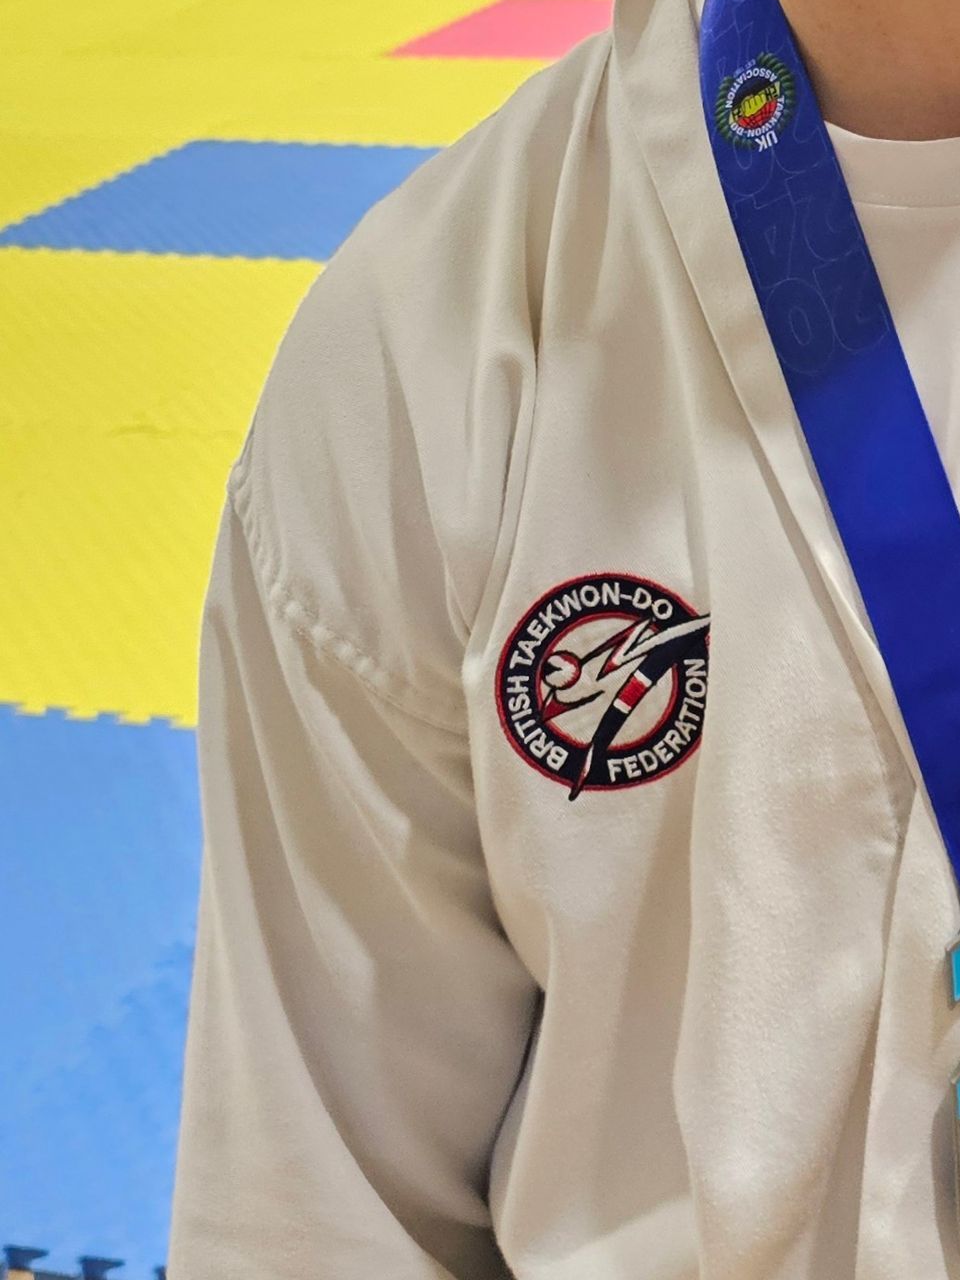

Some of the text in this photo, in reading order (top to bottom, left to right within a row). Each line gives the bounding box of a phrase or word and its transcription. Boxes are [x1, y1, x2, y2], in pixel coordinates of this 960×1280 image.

[725, 67, 778, 109] ASSOCIATION
[730, 94, 785, 138] TAEKWON-DO
[755, 130, 778, 153] UK
[506, 582, 673, 771] BRITISH TAEKWON-DO
[606, 658, 706, 783] FEDERATION
